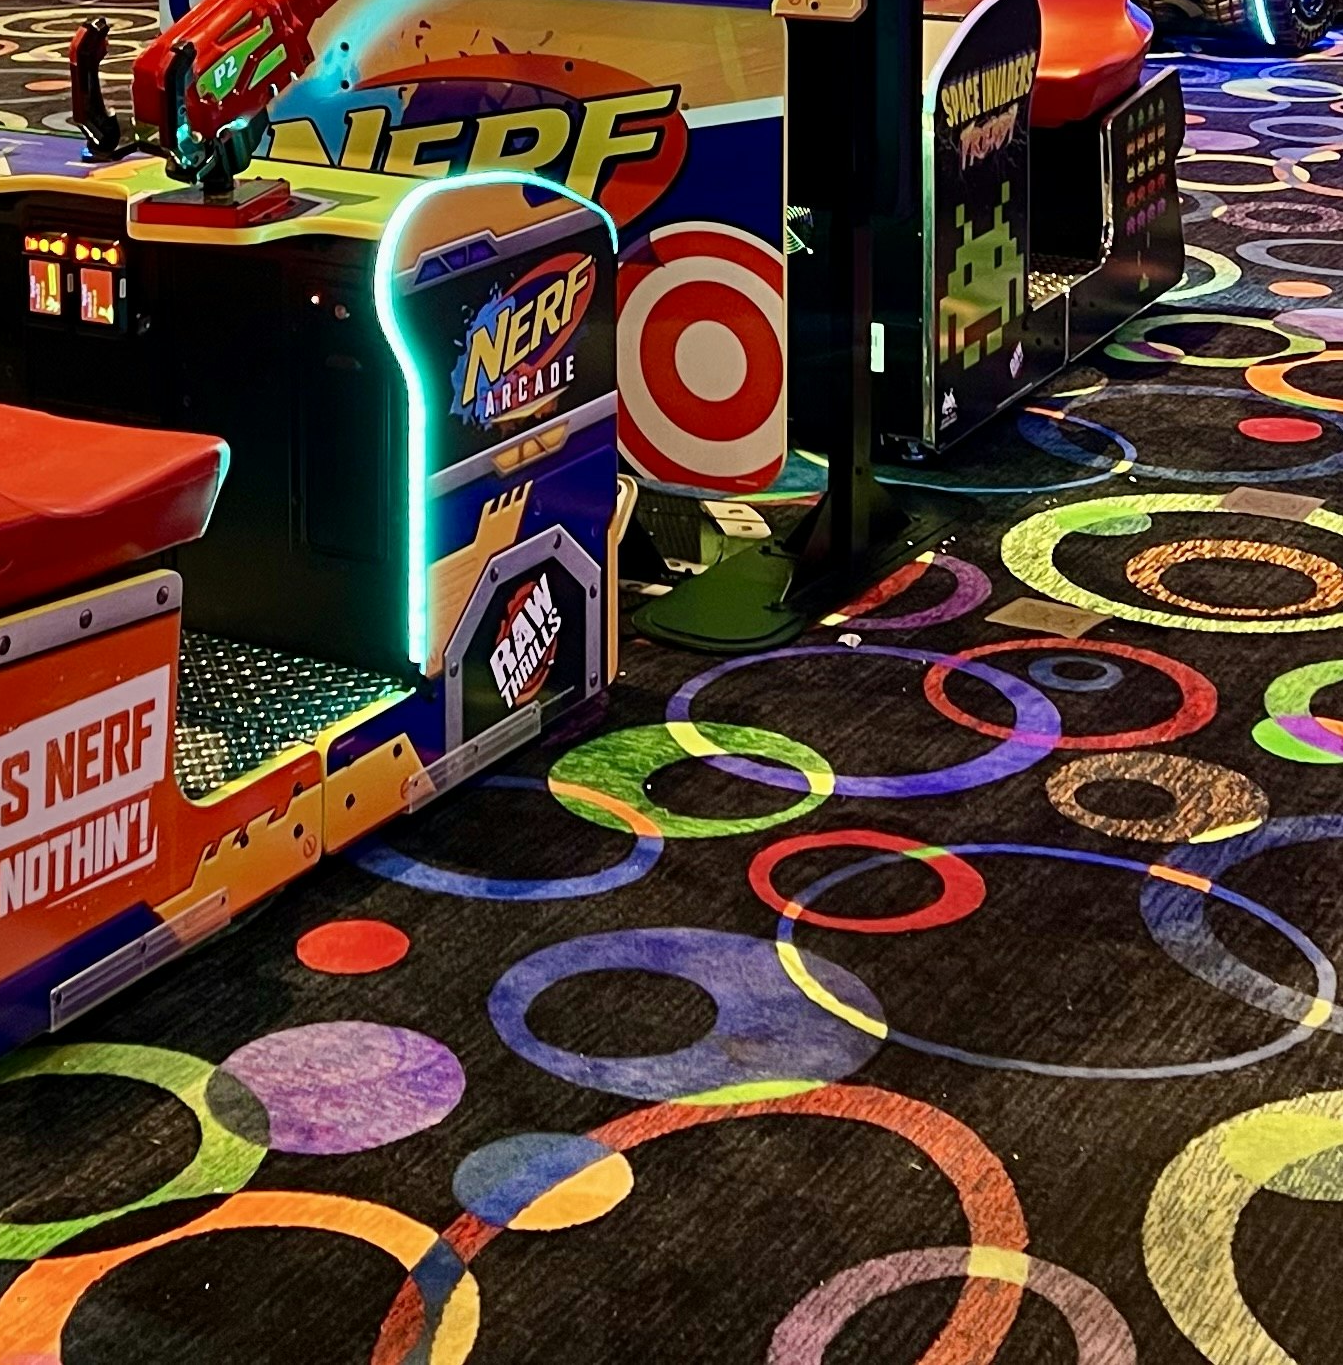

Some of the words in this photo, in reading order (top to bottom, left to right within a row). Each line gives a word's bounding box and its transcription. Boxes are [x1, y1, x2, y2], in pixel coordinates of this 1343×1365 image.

[211, 54, 240, 87] P2
[941, 73, 981, 128] SPACE
[981, 51, 1037, 113] INVADERS
[267, 88, 677, 210] NERF
[462, 253, 595, 407] NERF
[483, 355, 577, 419] ARCADE
[490, 571, 553, 689] RAW
[498, 608, 563, 708] THRILLS
[45, 697, 156, 809] NERF
